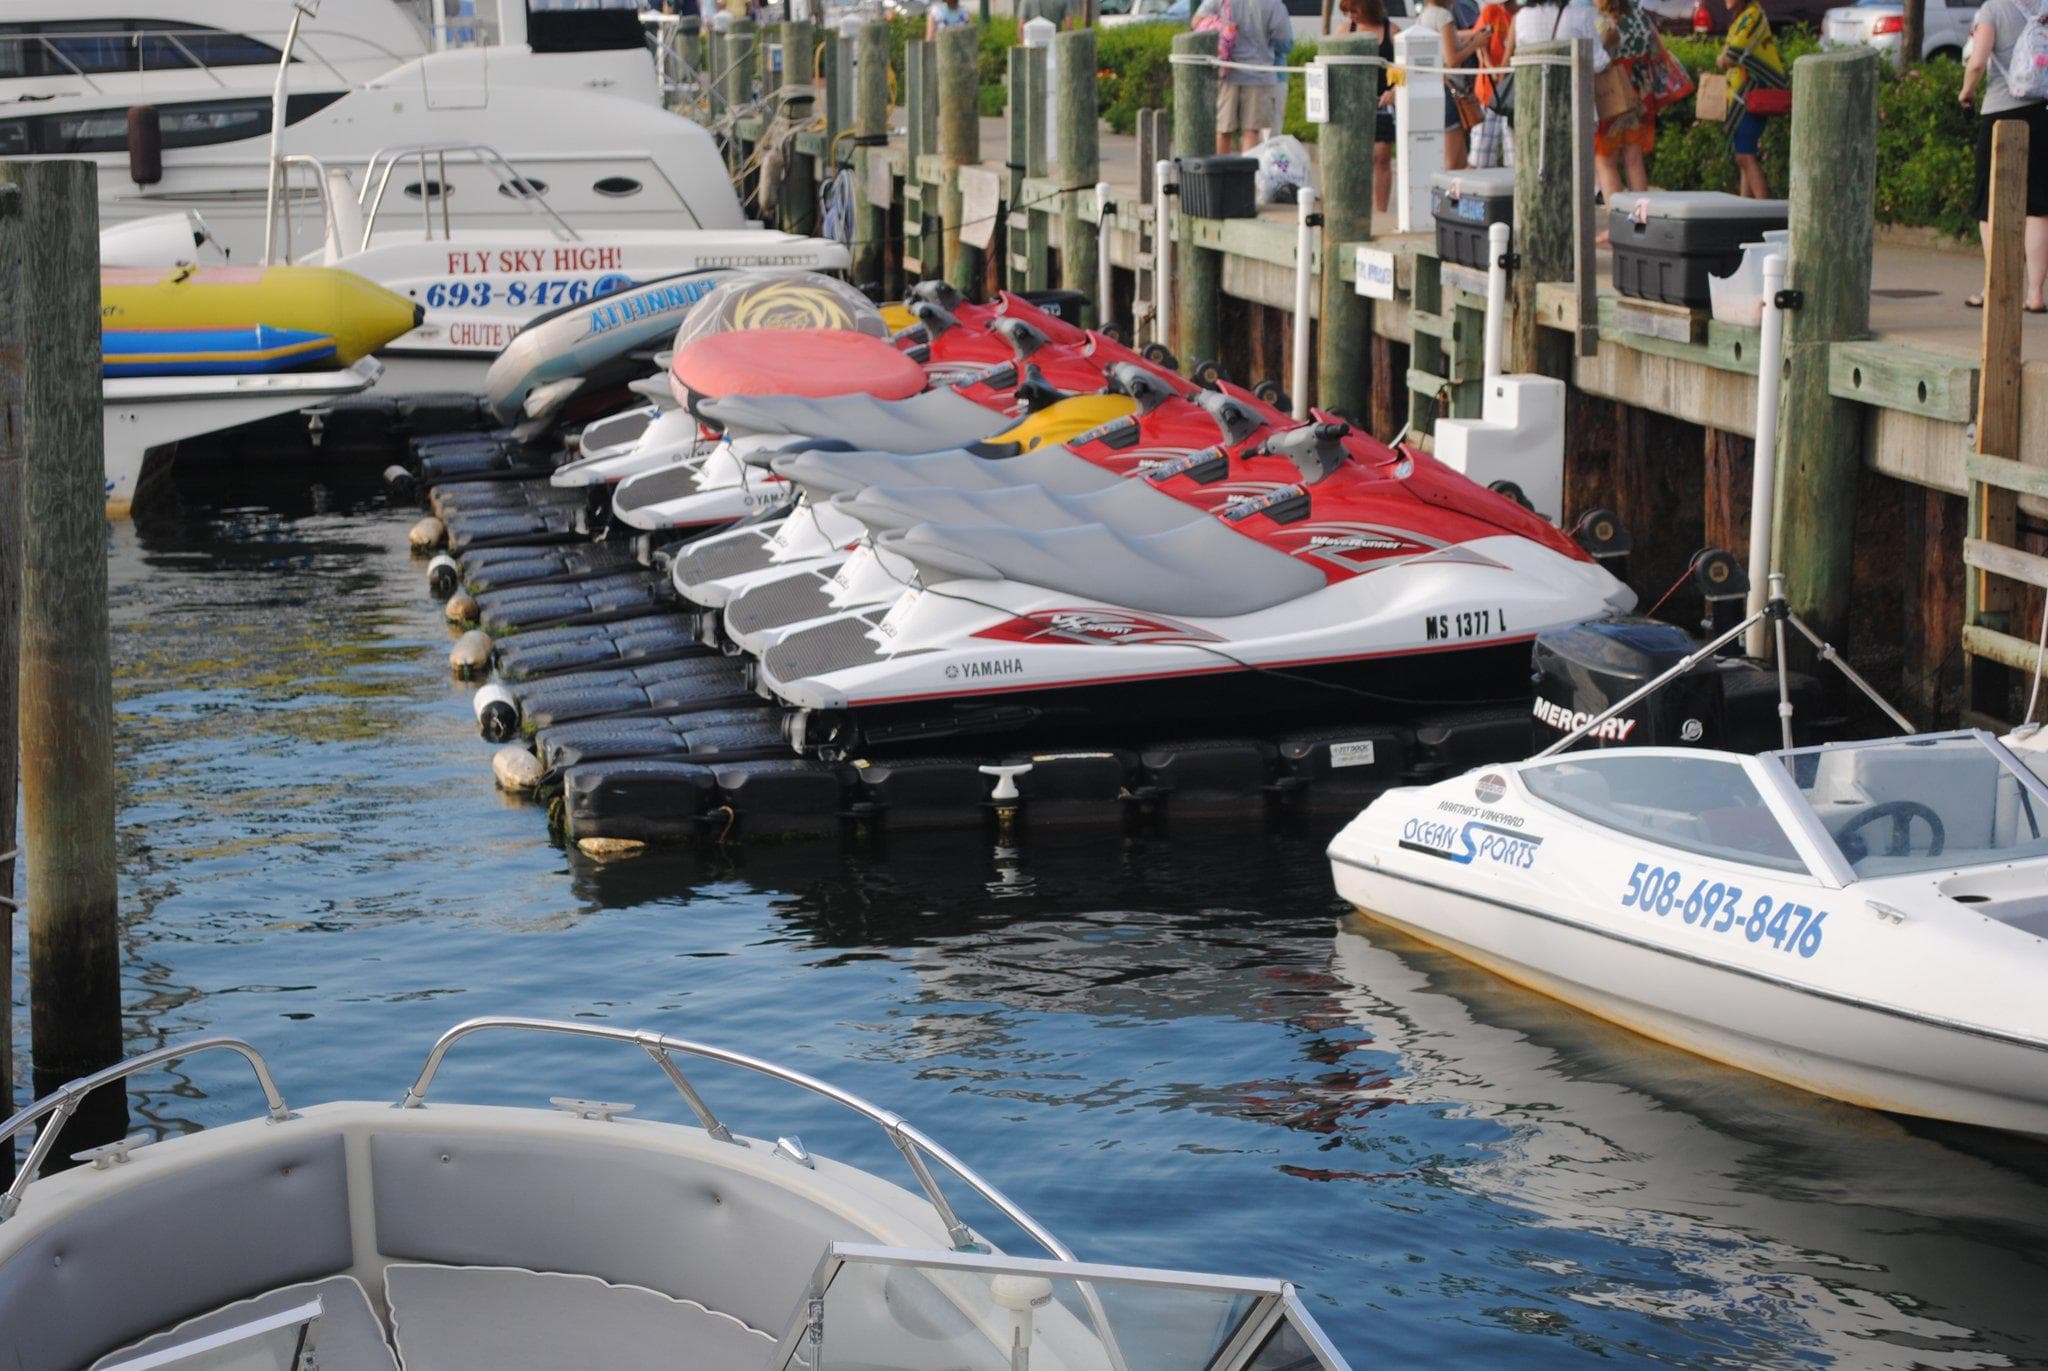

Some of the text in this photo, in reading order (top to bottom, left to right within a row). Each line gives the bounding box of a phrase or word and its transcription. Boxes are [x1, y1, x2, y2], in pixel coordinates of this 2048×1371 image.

[448, 247, 622, 274] FLY SKY HIGH!
[427, 280, 588, 308] 693-8476
[450, 322, 501, 346] CHUTE
[757, 493, 785, 505] YAM
[1426, 608, 1506, 640] MS 1377 L
[962, 658, 1023, 678] YAMAHA
[1481, 809, 1525, 828] VINEYARD
[1404, 818, 1537, 865] OCEAN SPORTS
[1621, 862, 1829, 959] 508-693-8476
